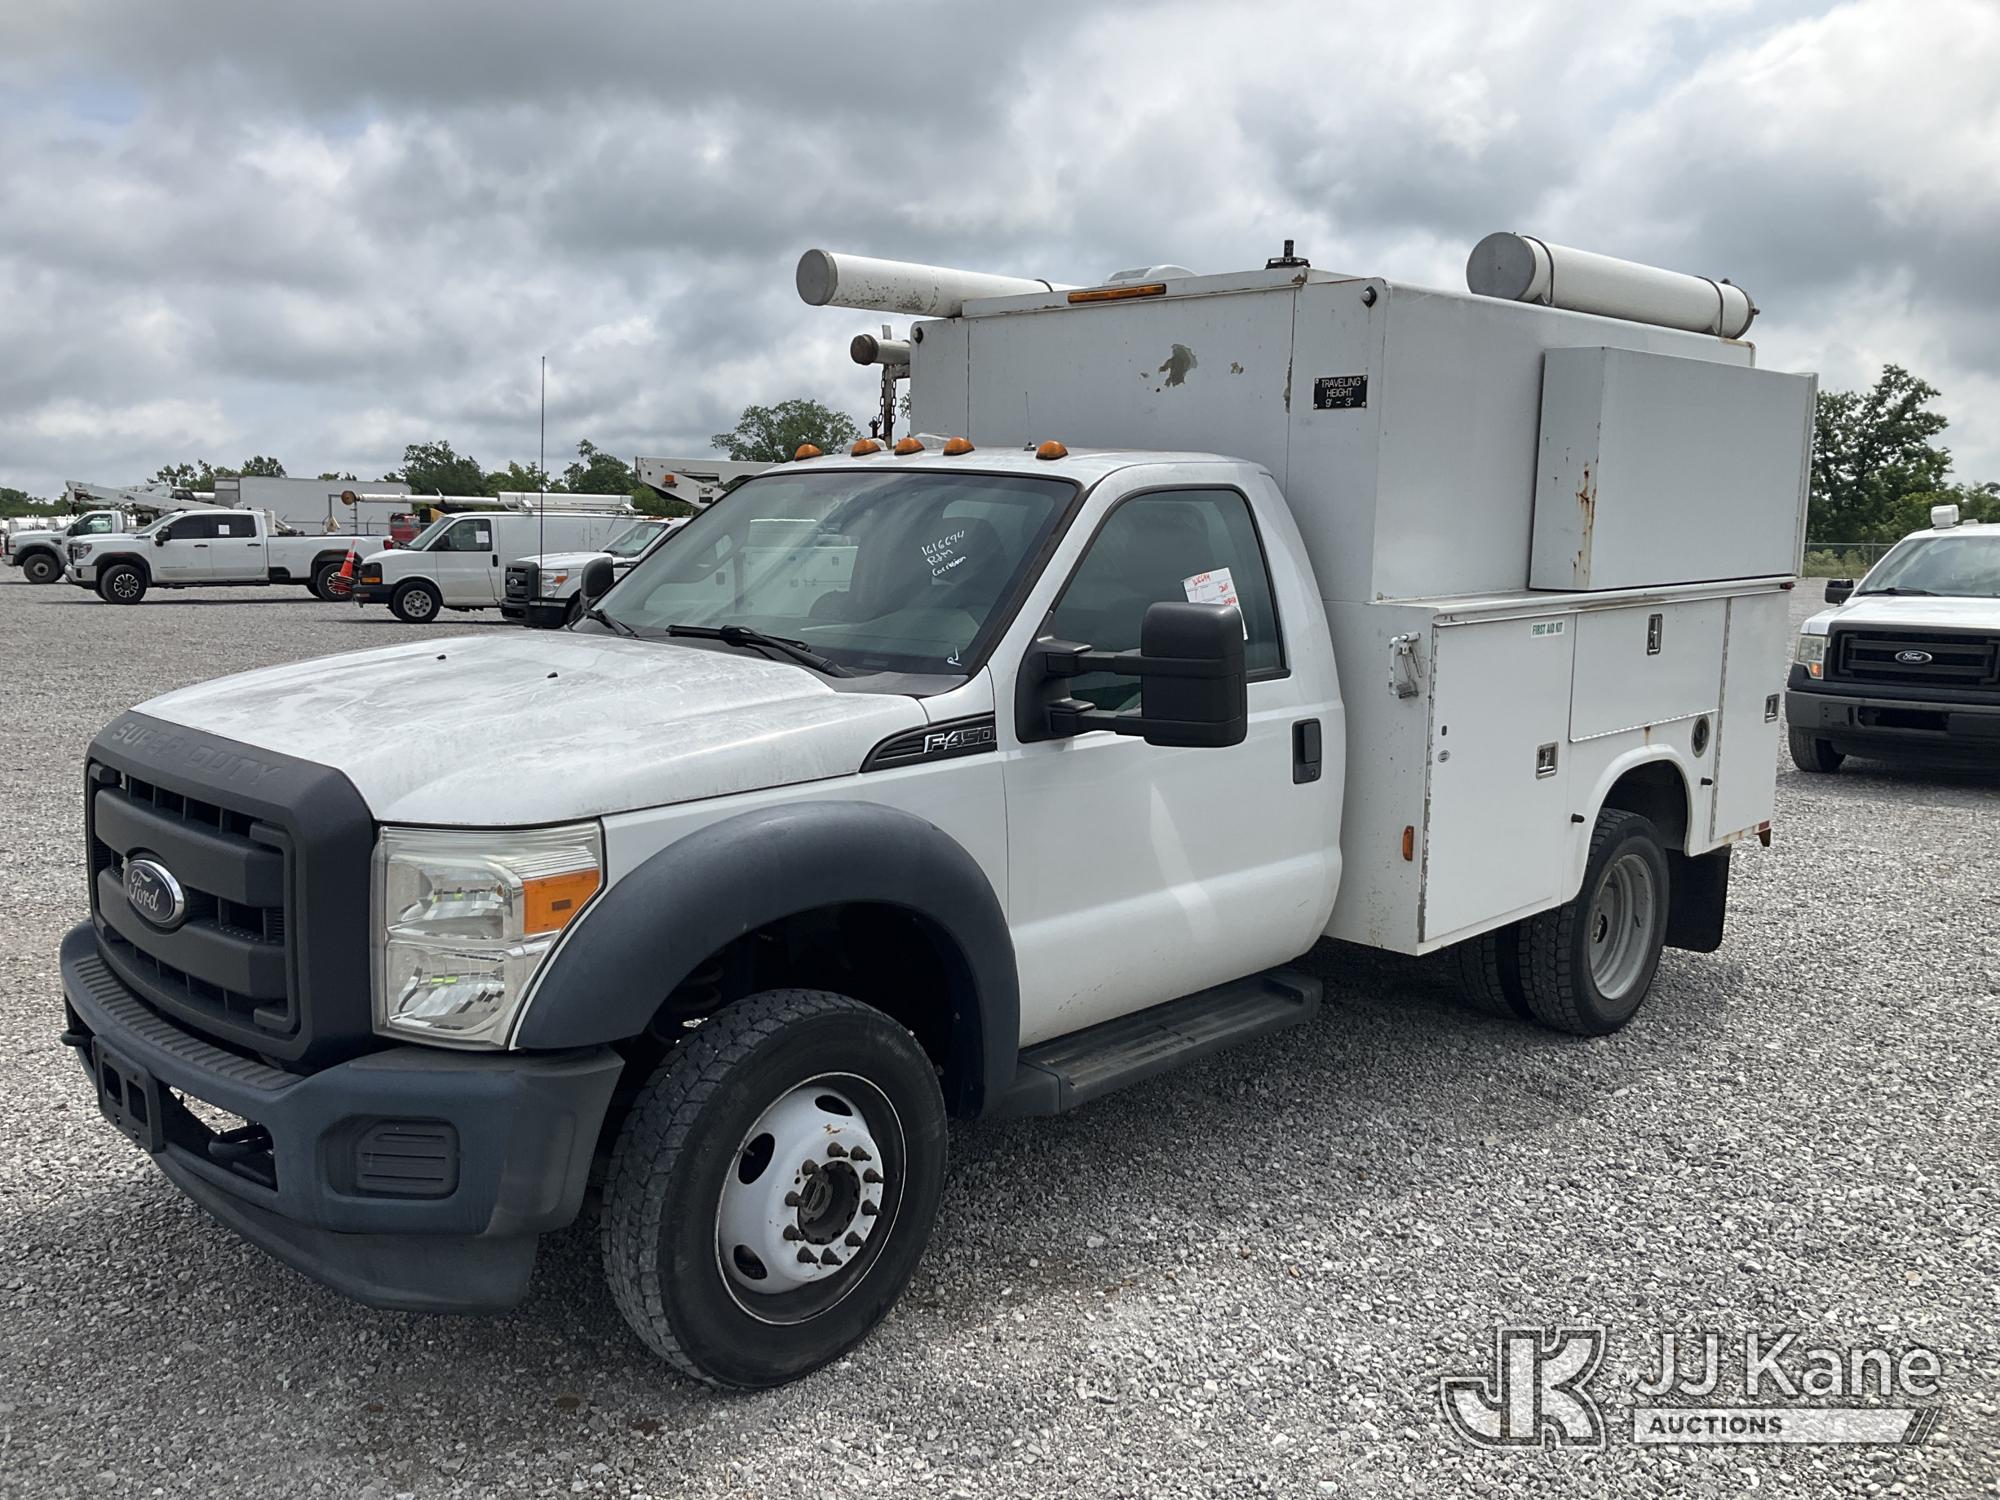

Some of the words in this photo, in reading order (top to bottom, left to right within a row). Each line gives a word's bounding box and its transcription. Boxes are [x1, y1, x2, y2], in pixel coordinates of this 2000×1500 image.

[1321, 377, 1361, 388] TRAVELING
[1326, 387, 1353, 398] HEIGHT
[921, 530, 965, 556] 1616694
[1532, 624, 1546, 635] FIRST
[1547, 623, 1555, 634] AID
[111, 720, 187, 757] SUPER
[184, 744, 285, 785] DUTY
[923, 726, 995, 753] F-450
[128, 868, 160, 912] Ford
